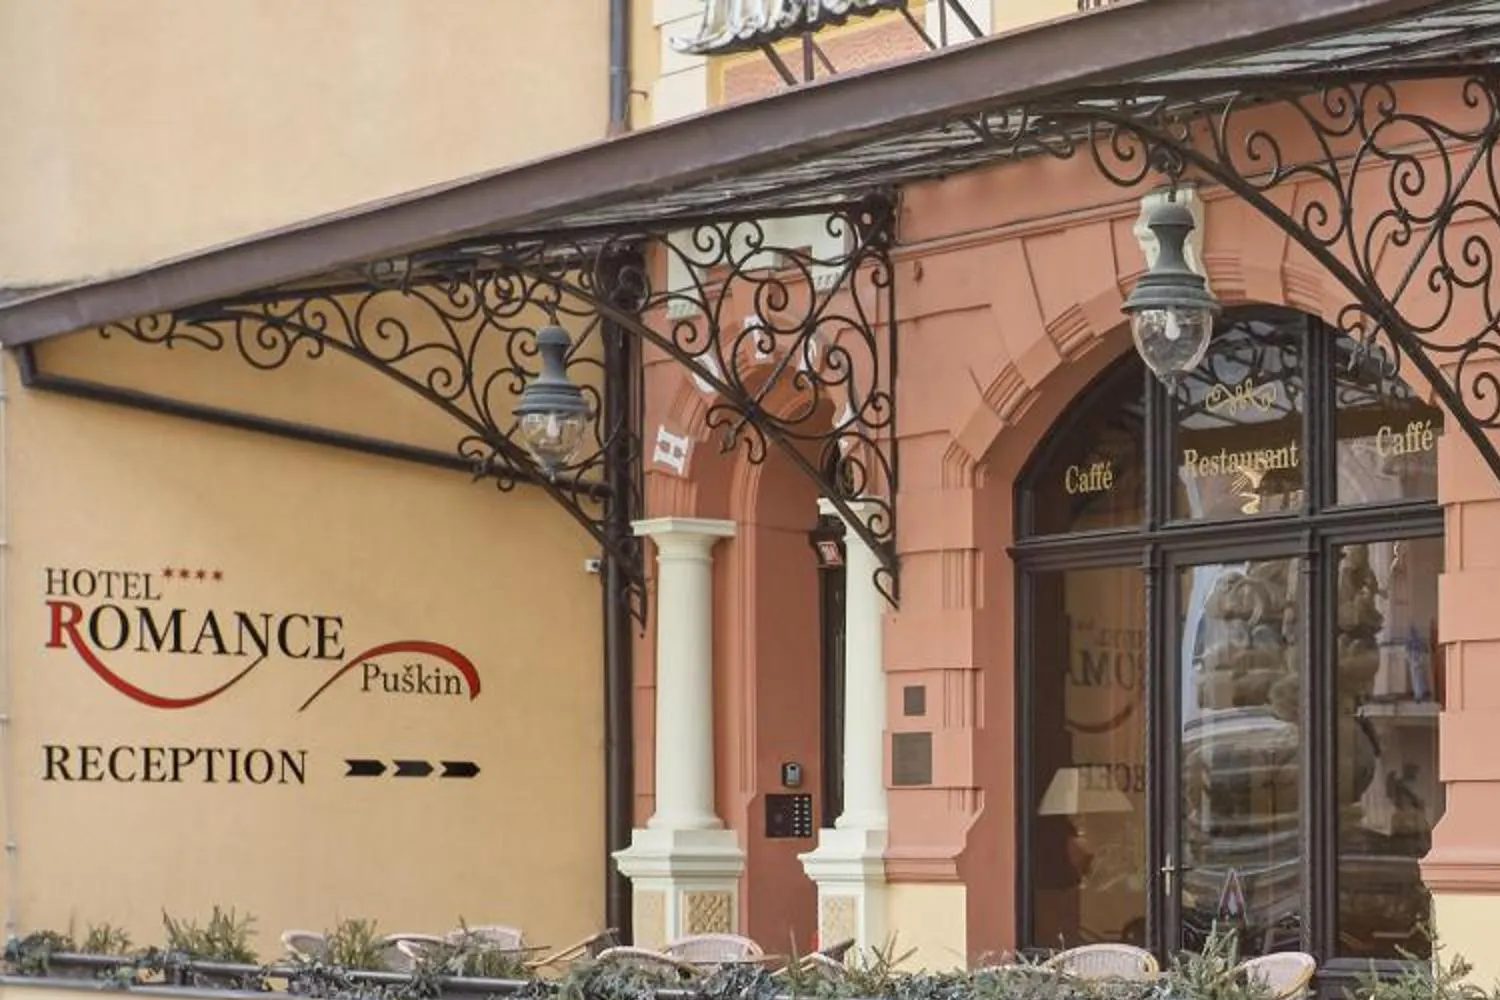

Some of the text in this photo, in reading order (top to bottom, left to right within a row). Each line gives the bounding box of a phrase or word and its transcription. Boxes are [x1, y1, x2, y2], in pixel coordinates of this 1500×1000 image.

[1065, 420, 1433, 494] Caffé Restaurant Caffé
[44, 567, 163, 600] HOTEL
[45, 600, 345, 661] ROMANCE
[360, 661, 464, 697] Puškin
[42, 744, 308, 784] RECEPTION
